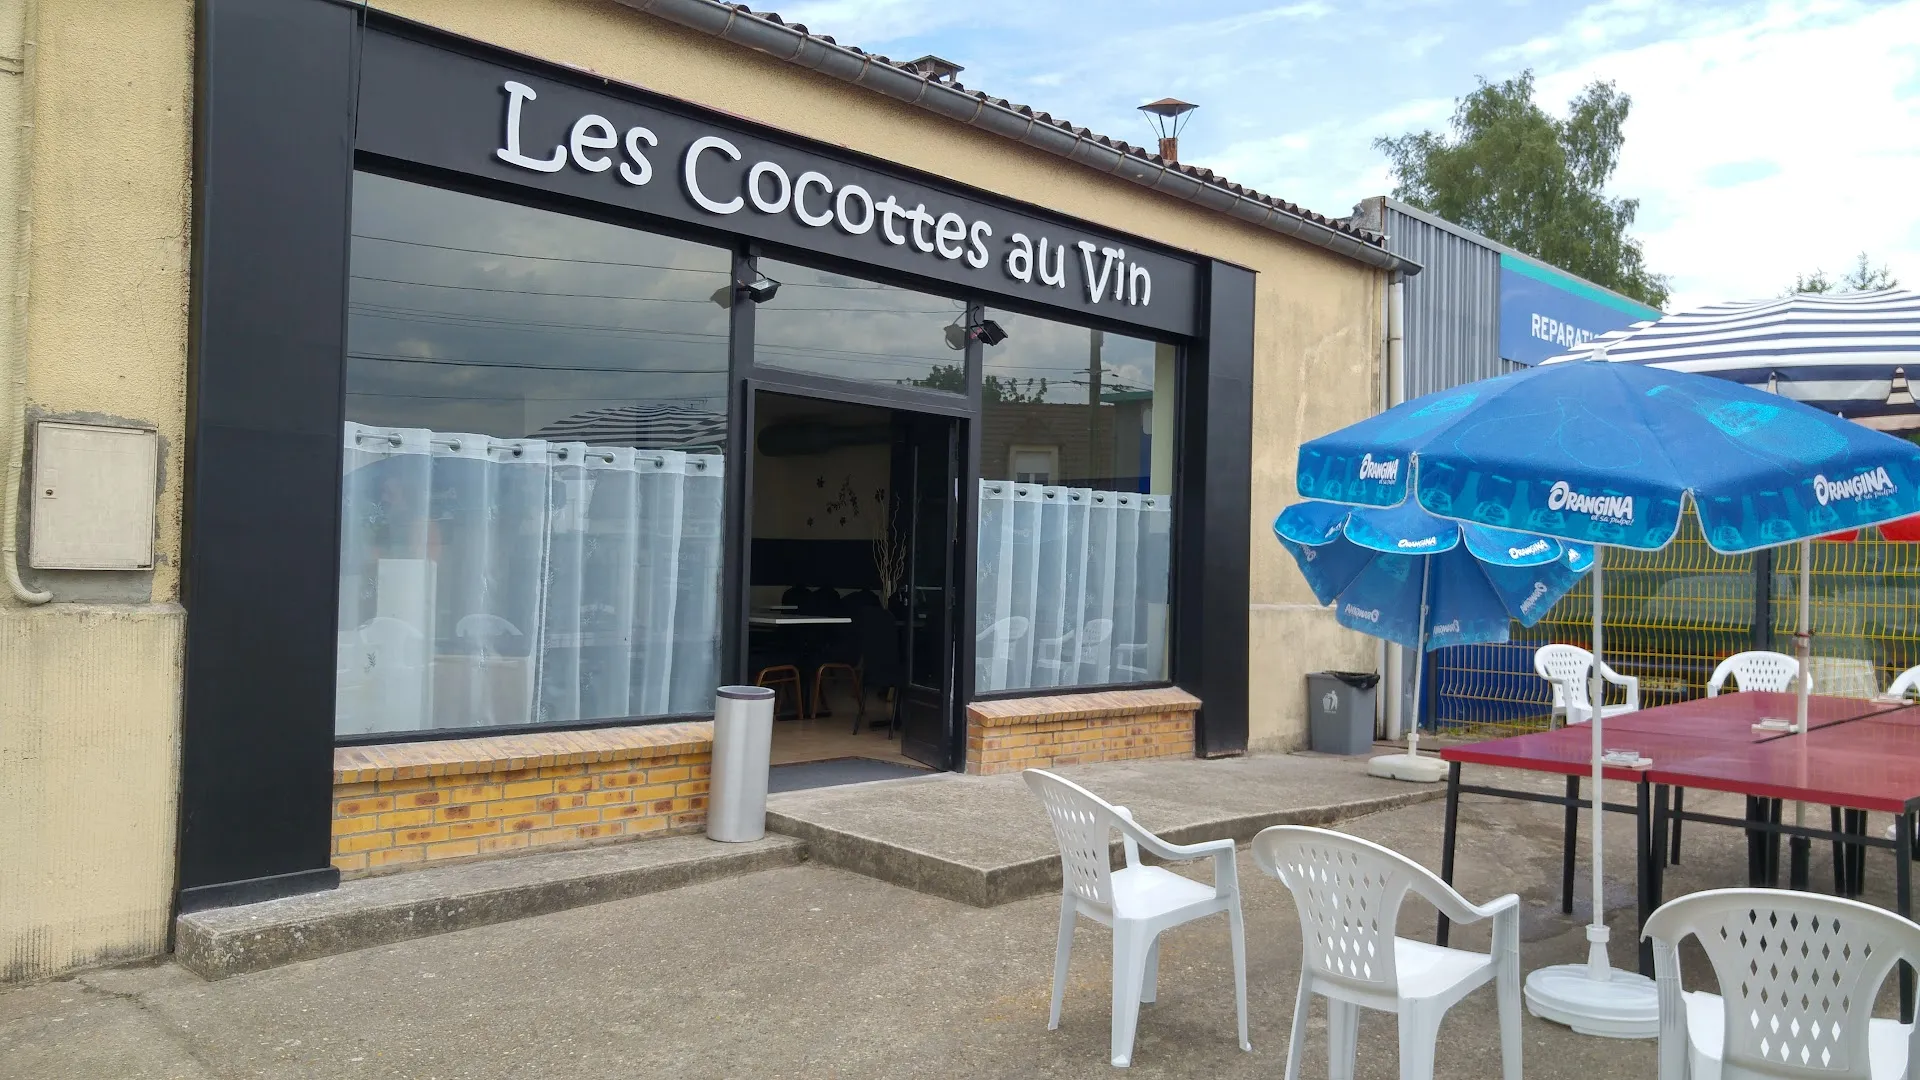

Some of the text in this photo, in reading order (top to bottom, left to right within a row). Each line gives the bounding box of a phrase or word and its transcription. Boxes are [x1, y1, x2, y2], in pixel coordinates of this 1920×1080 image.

[496, 80, 1152, 307] Les Cocottes au Vin
